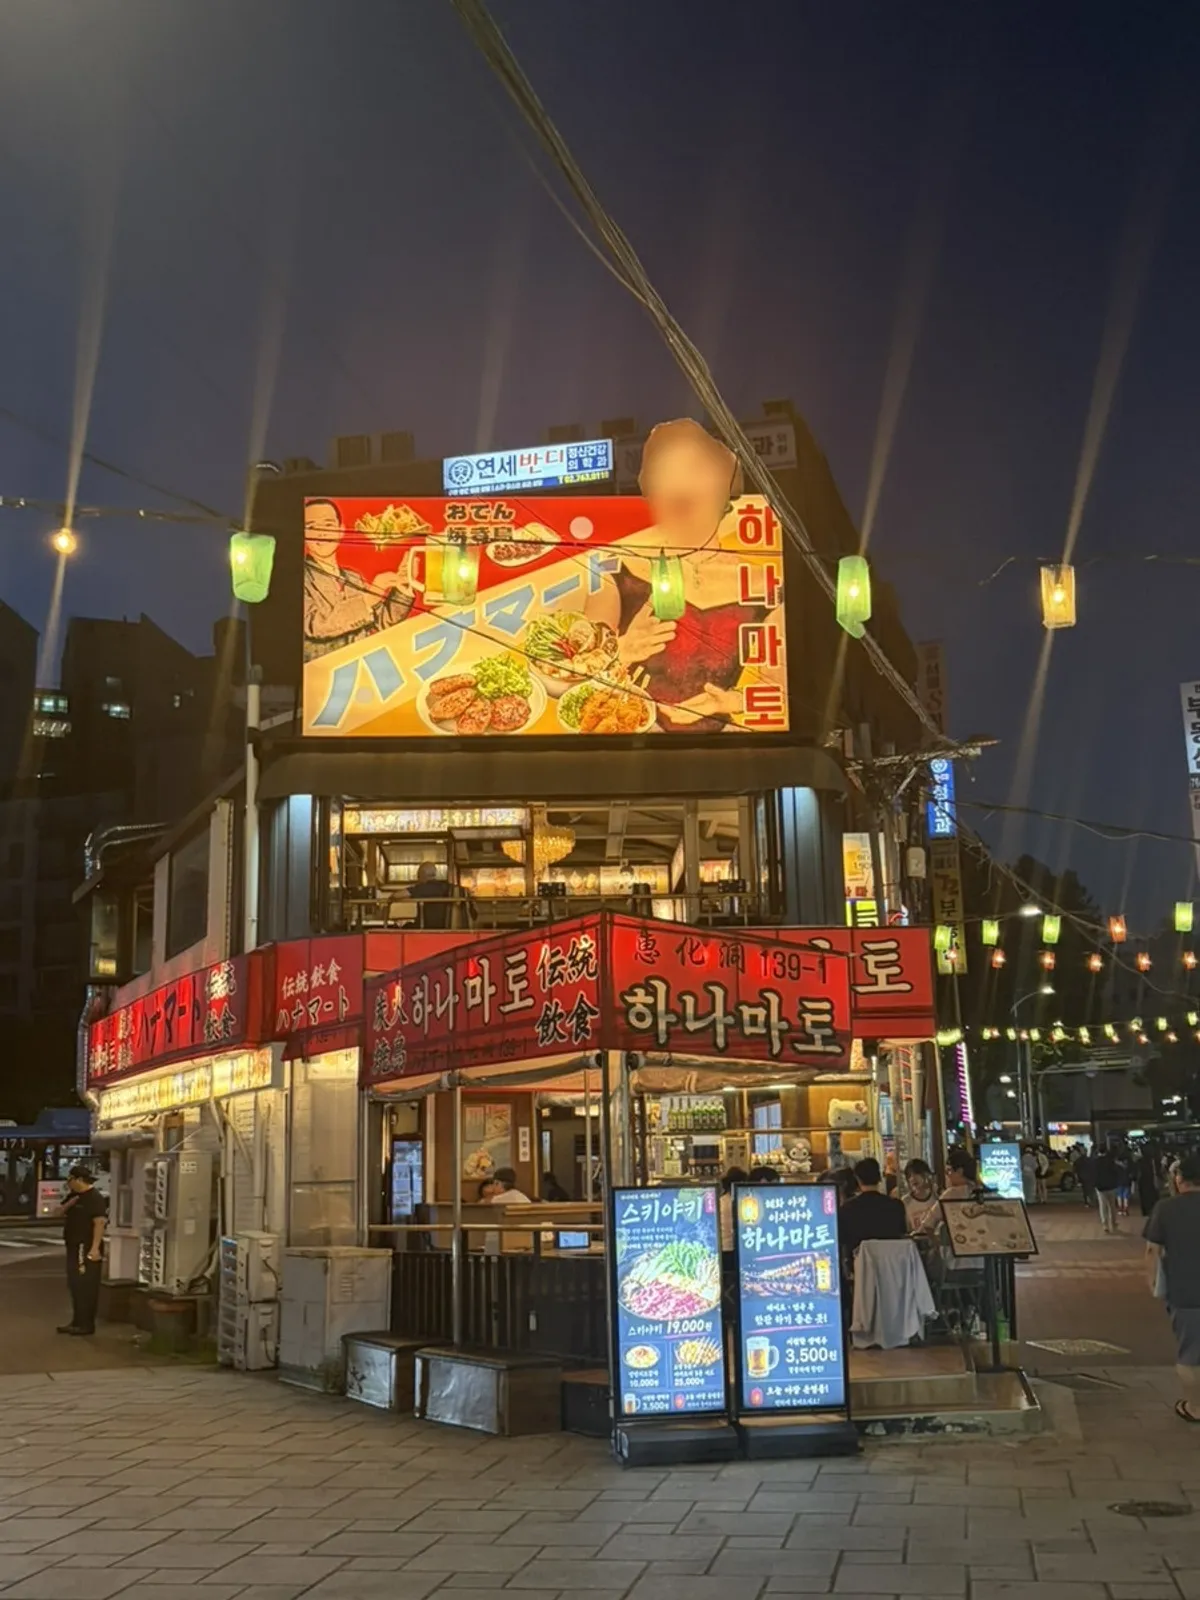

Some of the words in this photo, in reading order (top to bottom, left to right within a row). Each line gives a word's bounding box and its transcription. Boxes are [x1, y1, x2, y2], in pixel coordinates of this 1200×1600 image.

[568, 443, 607, 457] 정신건강
[445, 503, 515, 521] おでん
[737, 503, 786, 728] 하나마토
[537, 934, 599, 993] 伝統
[758, 948, 828, 984] 139-1
[276, 985, 350, 1033] ハナマート
[411, 950, 534, 1036] 하나마토
[535, 990, 600, 1047] 飲食
[622, 976, 843, 1057] 하나마토
[3, 1137, 25, 1149] 171
[621, 1196, 703, 1225] 스키야키
[769, 1208, 813, 1224] 이자카야
[741, 1224, 835, 1252] 하나마토
[785, 1347, 838, 1365] 3,500원
